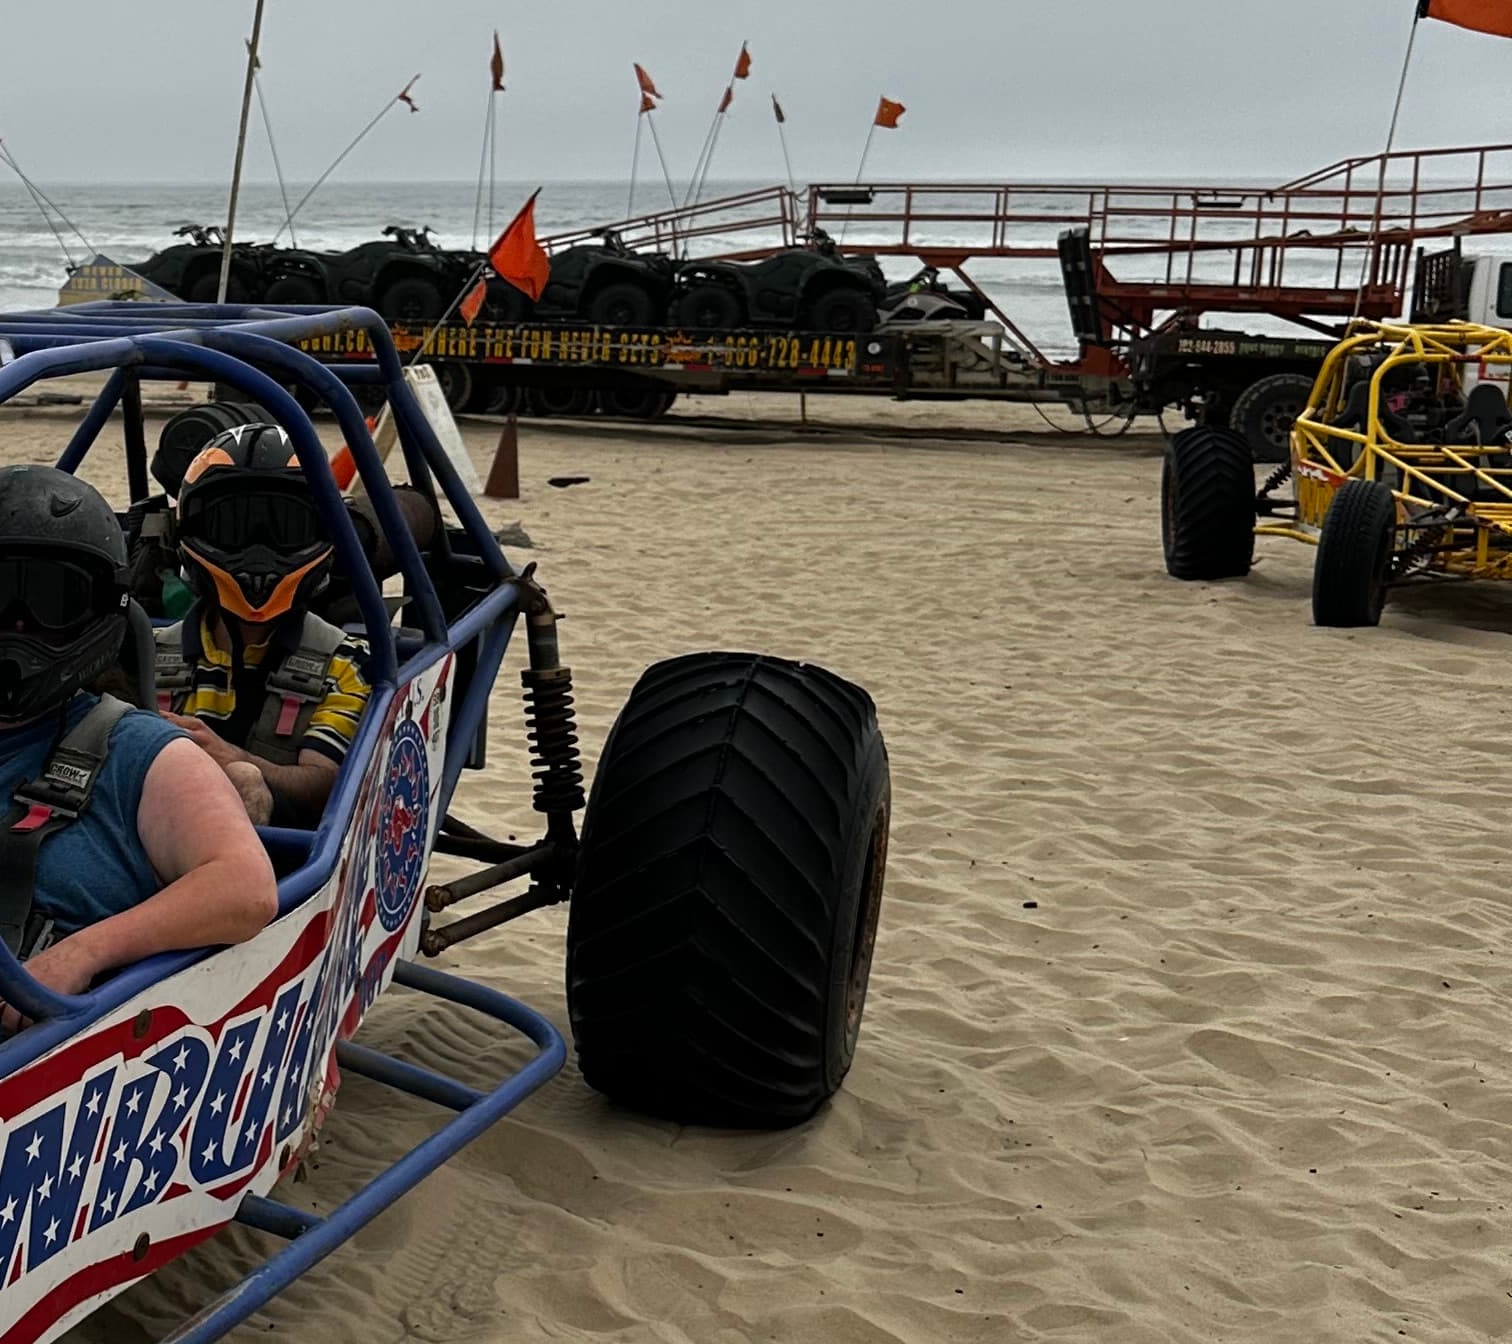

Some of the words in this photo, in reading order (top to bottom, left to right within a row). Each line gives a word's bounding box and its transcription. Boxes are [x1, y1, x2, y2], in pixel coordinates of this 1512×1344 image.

[485, 328, 513, 357] THE
[521, 330, 552, 359] FUN
[559, 330, 610, 361] NEVER
[619, 332, 660, 364] SETS
